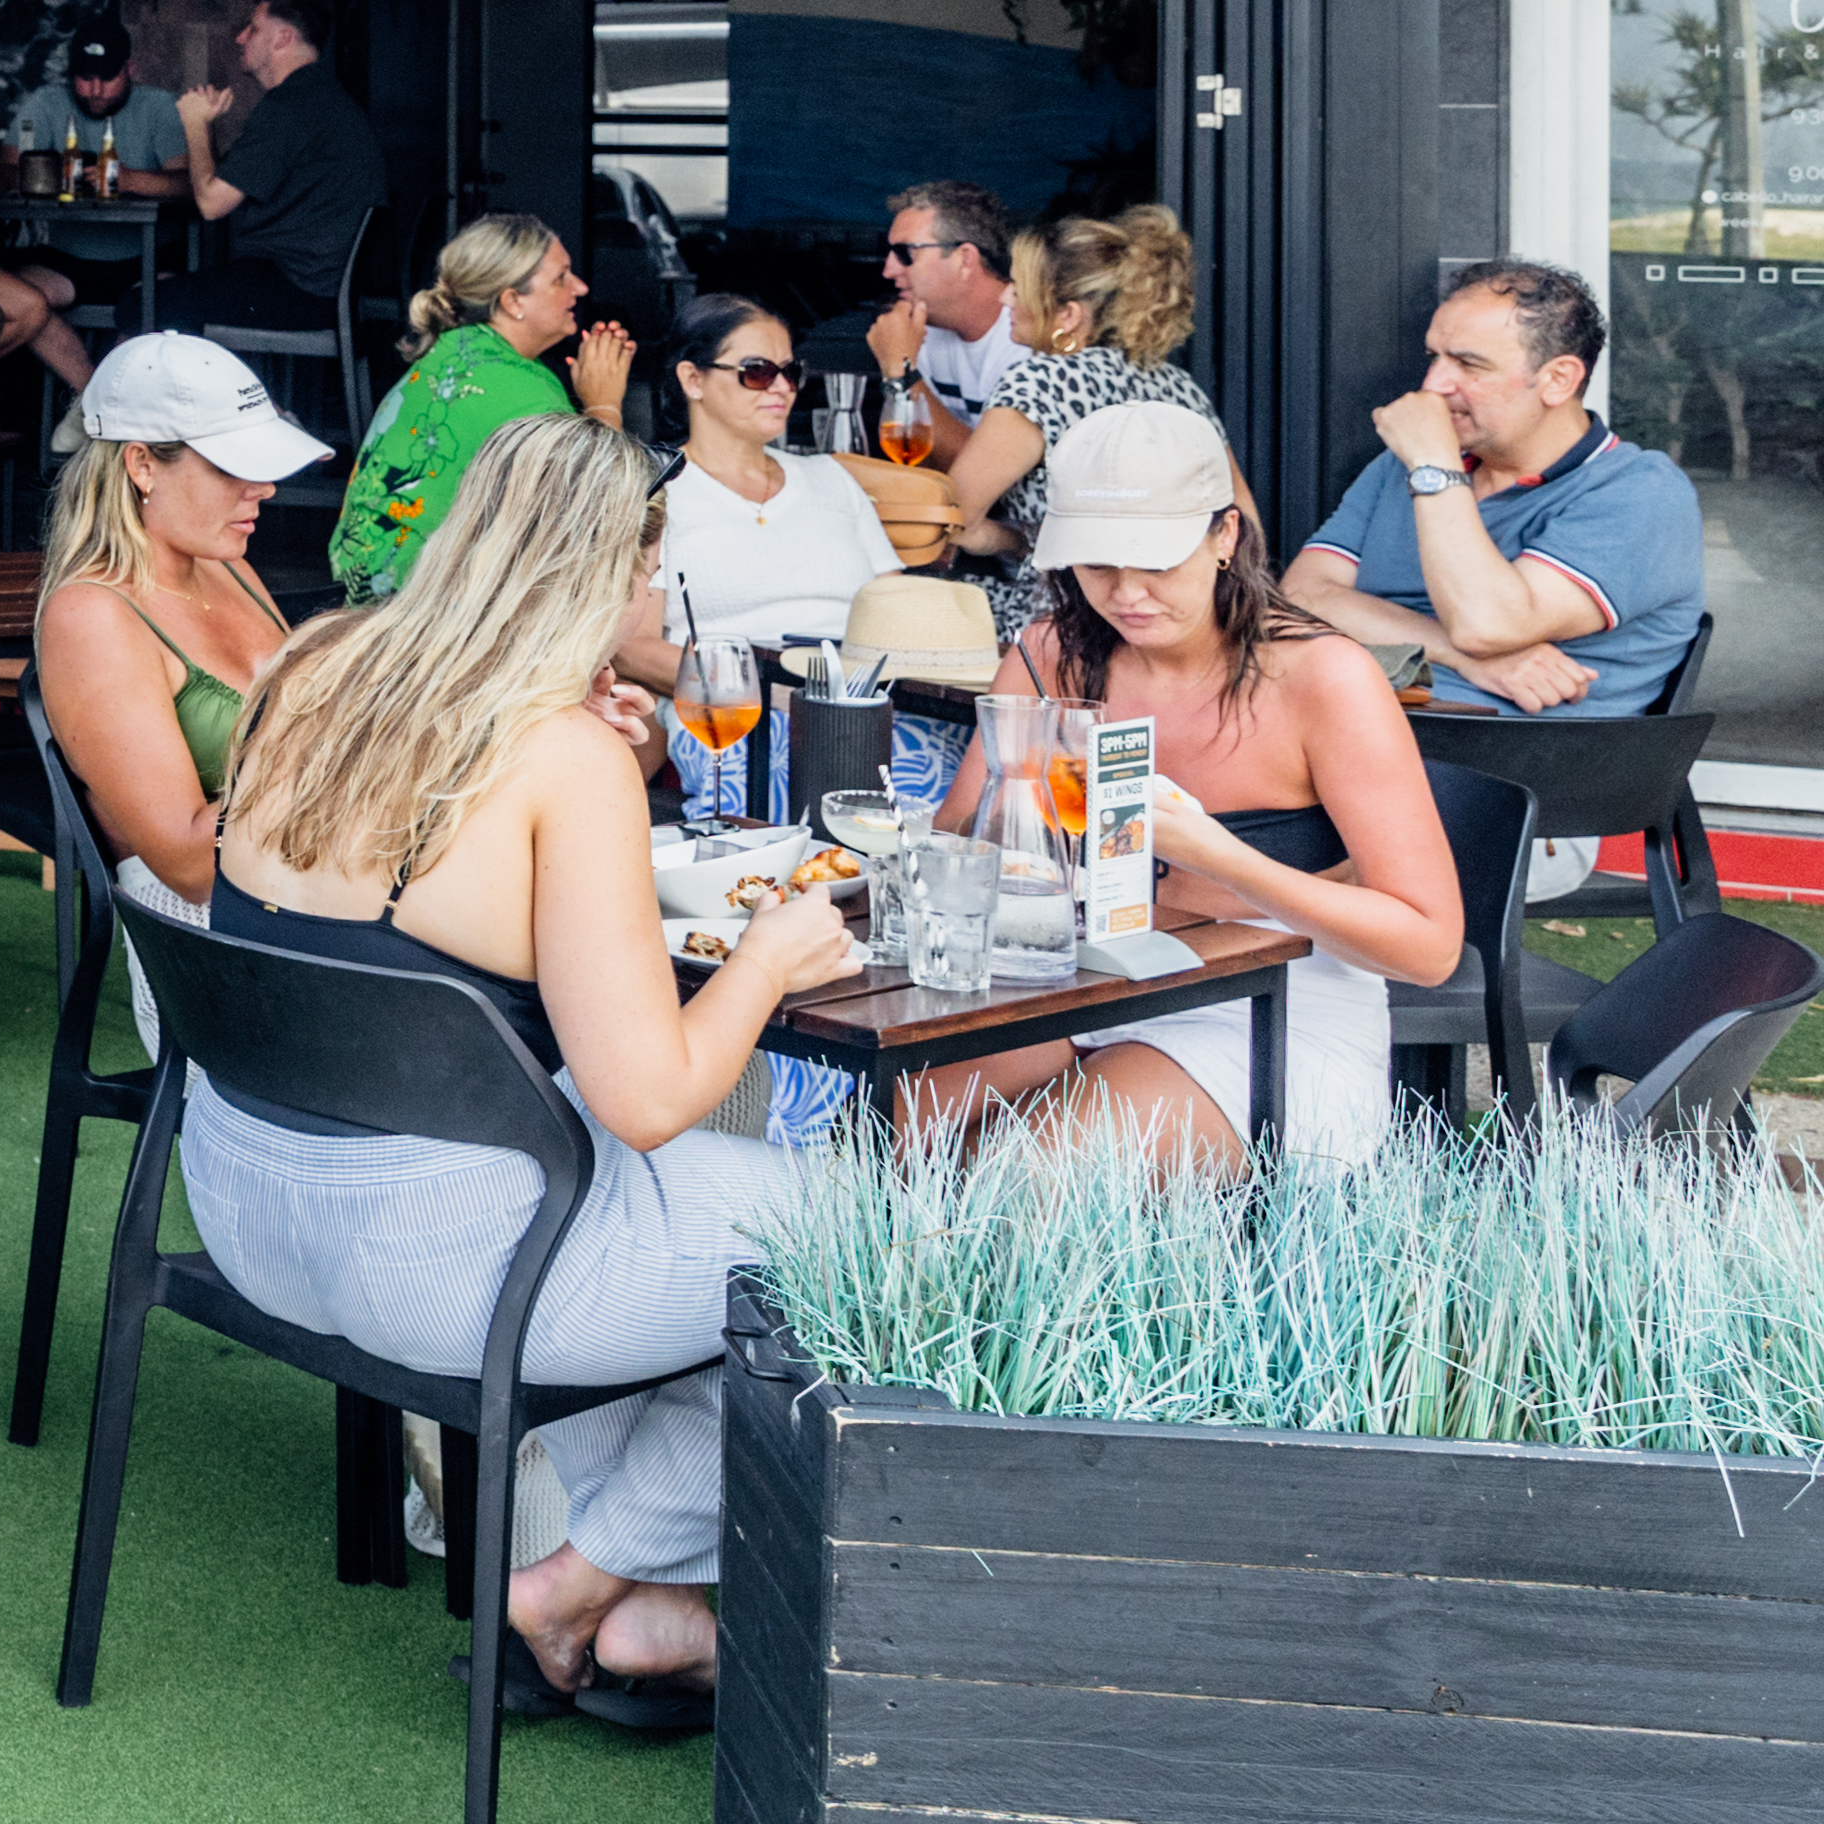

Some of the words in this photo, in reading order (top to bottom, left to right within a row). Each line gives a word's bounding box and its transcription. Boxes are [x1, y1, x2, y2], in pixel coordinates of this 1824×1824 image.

[1704, 43, 1785, 59] Hair
[1803, 44, 1820, 60] &
[1099, 731, 1148, 755] 3PM-5PM
[1115, 782, 1143, 797] WINGS
